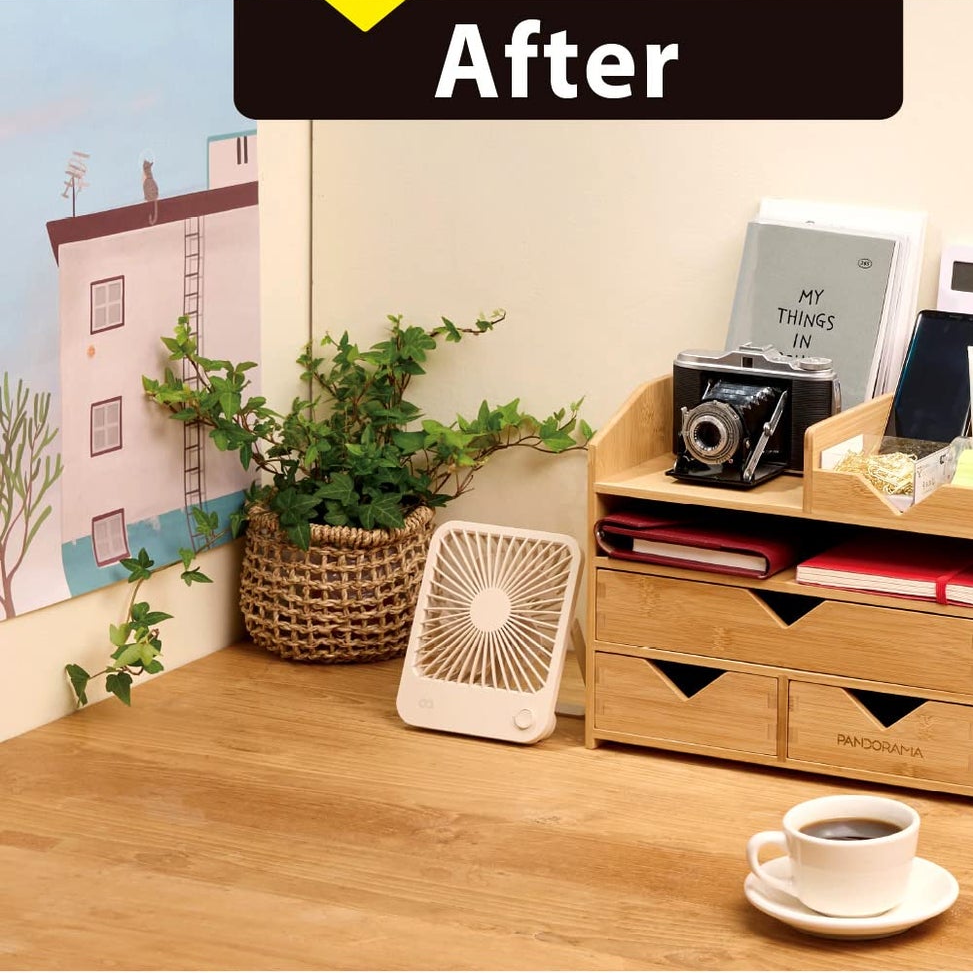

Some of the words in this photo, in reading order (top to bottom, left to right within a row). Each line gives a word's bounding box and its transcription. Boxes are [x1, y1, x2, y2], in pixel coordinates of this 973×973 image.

[798, 289, 825, 306] MY
[777, 307, 836, 331] THINGS
[792, 333, 812, 349] IN
[837, 733, 924, 759] PANDORAMA
